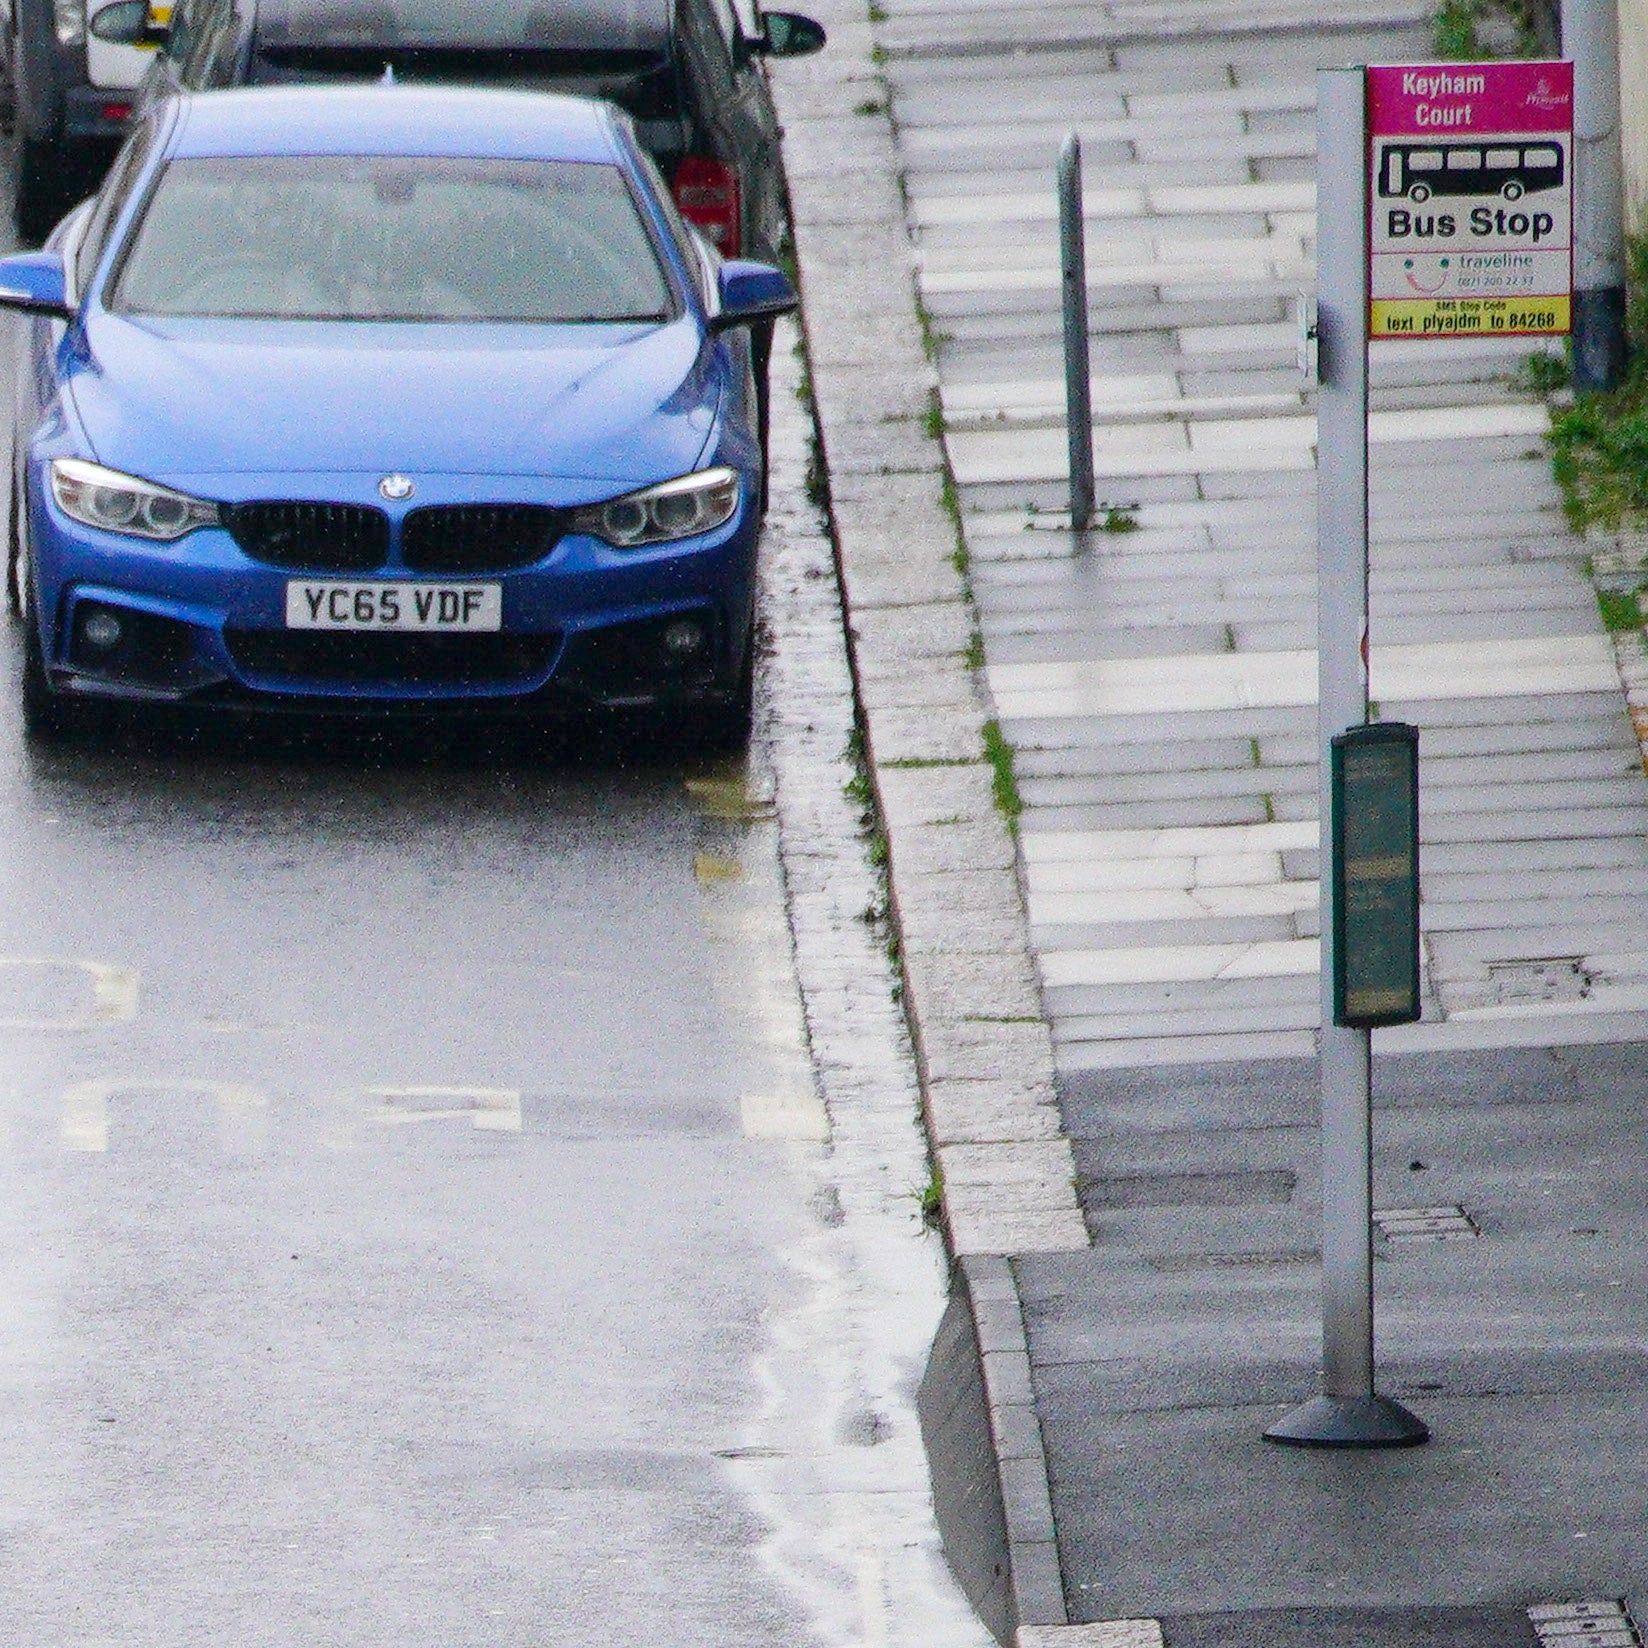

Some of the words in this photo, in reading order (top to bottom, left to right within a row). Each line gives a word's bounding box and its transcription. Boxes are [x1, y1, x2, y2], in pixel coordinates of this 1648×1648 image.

[1402, 73, 1485, 99] Keyham
[1415, 103, 1473, 126] Court
[1388, 209, 1456, 239] Bus
[1469, 207, 1554, 242] Stop
[1460, 253, 1533, 269] traveline
[1387, 314, 1413, 332] text
[1491, 314, 1504, 330] to
[1509, 312, 1555, 330] 84268
[304, 587, 401, 624] YC65
[413, 588, 484, 625] VDF
